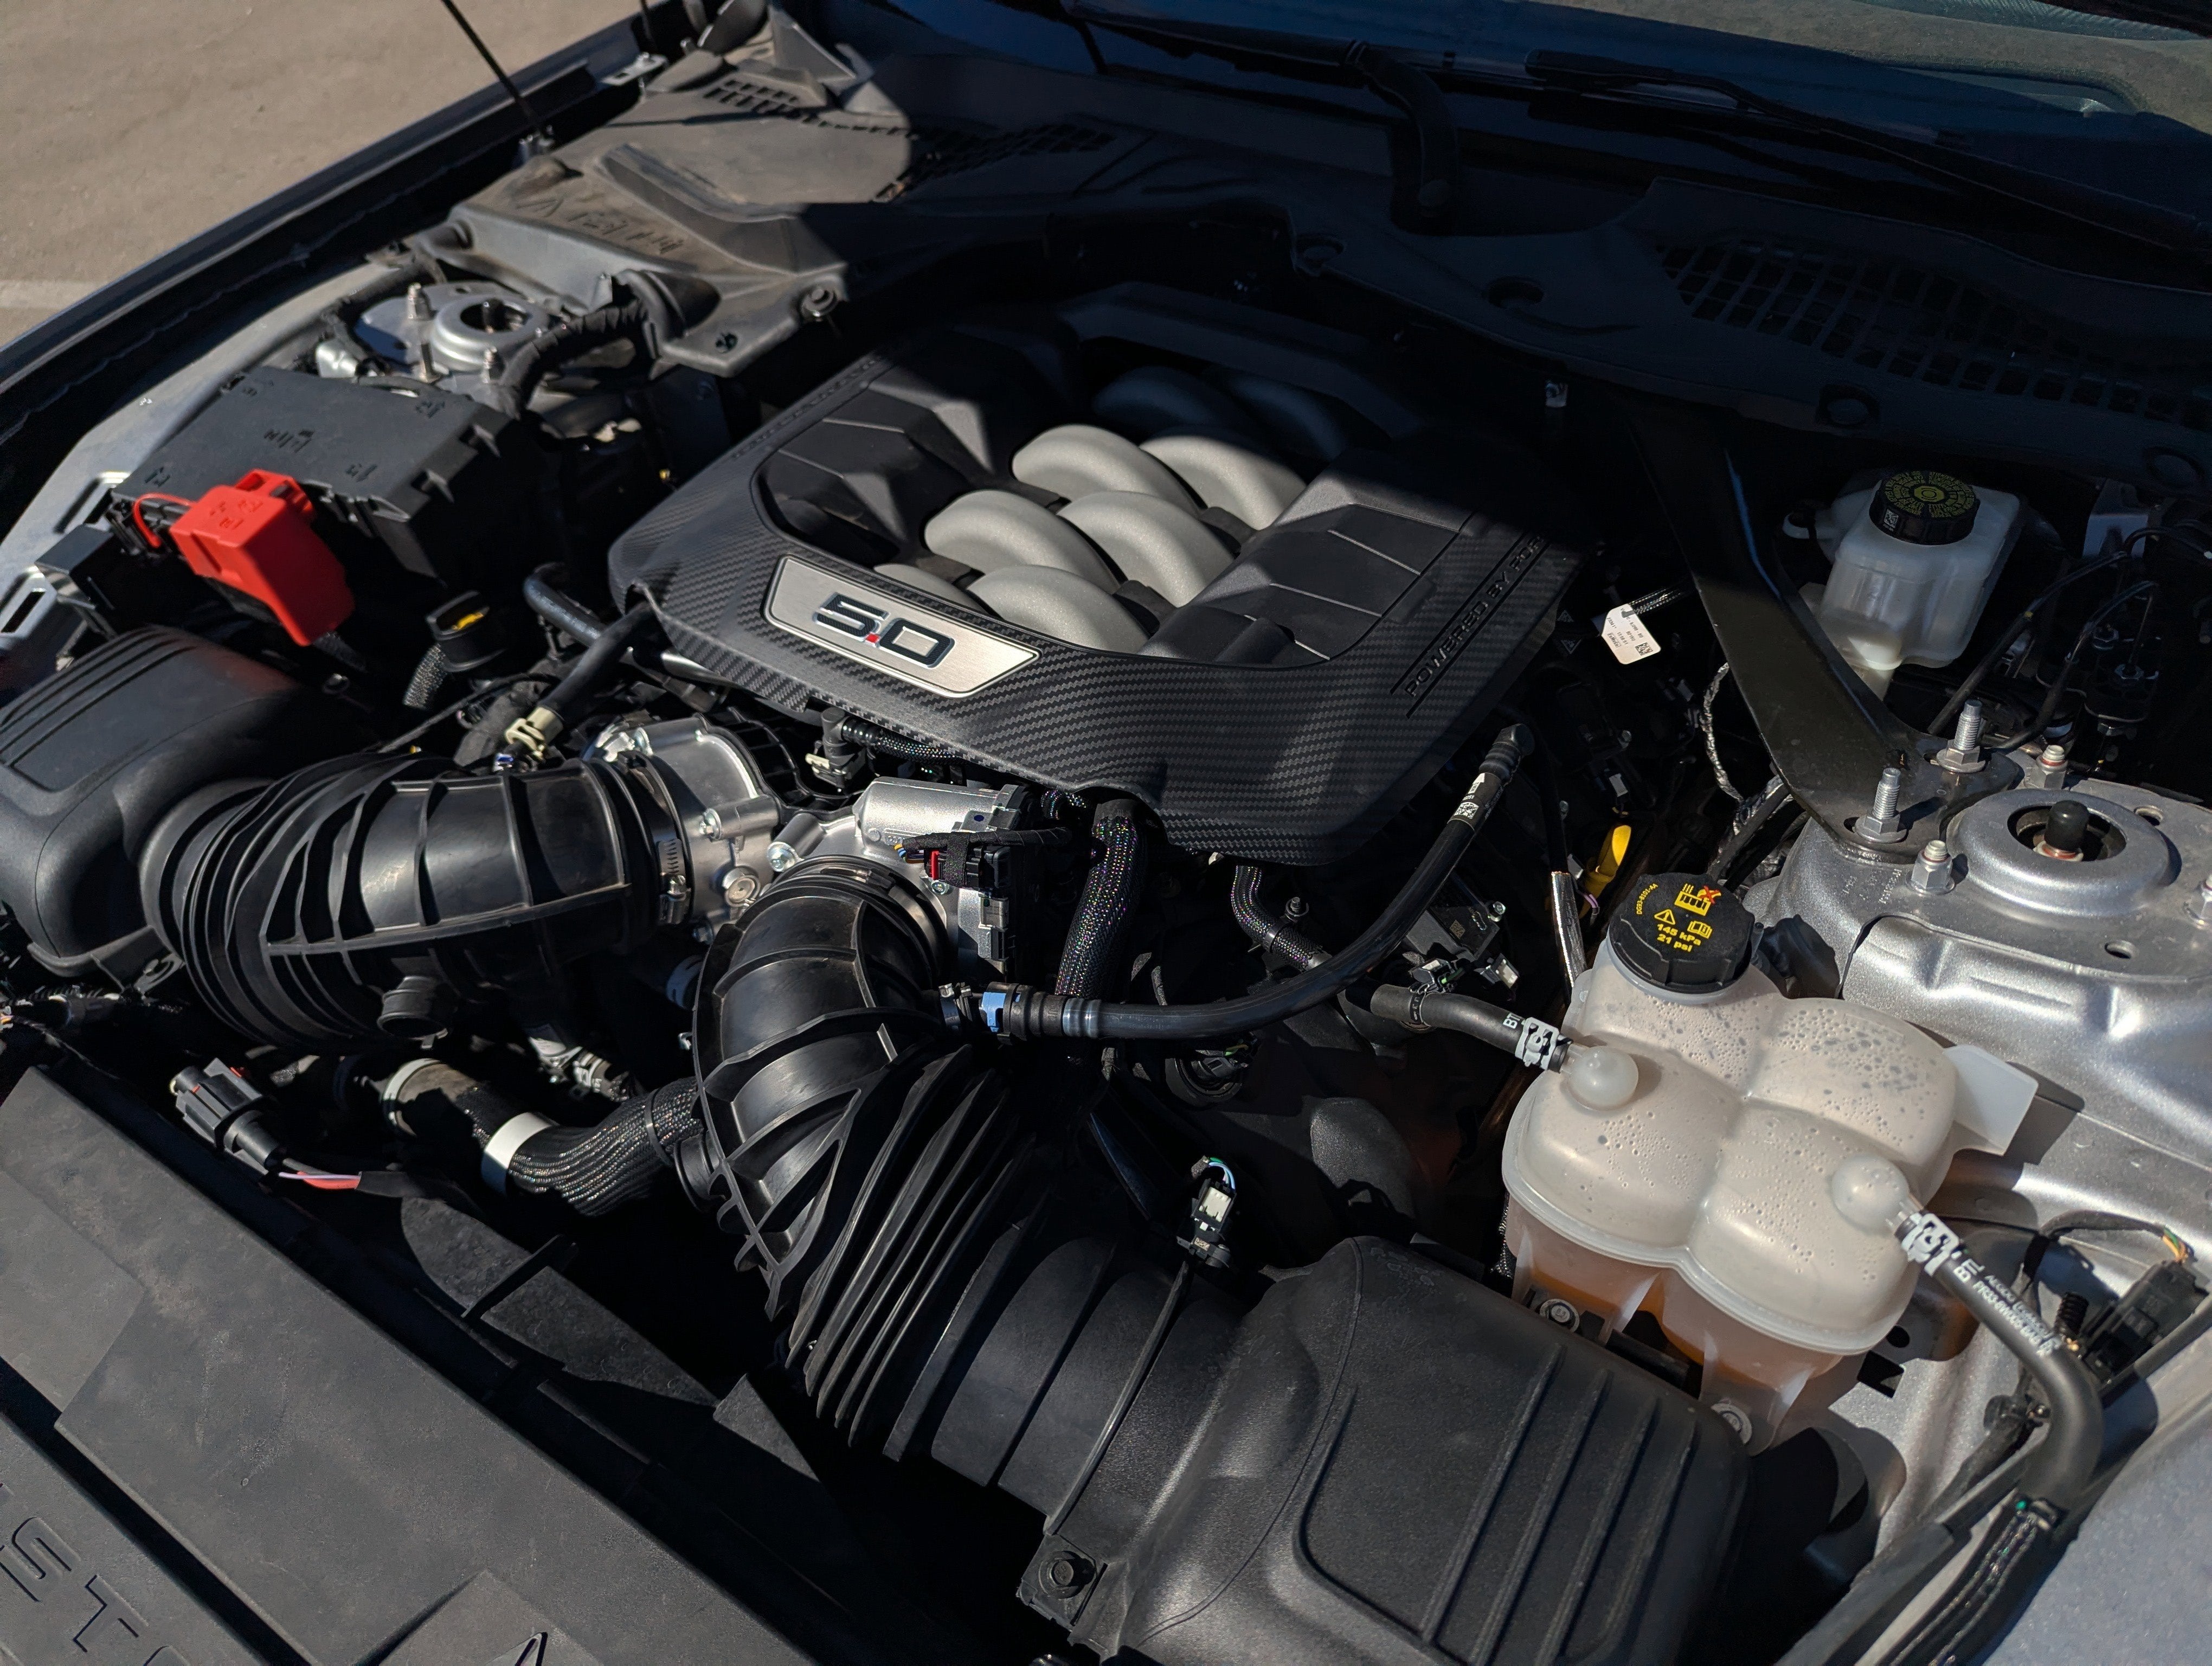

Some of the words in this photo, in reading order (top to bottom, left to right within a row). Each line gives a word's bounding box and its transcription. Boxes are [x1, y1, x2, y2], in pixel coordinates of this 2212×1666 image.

[812, 592, 956, 670] 5.0
[1404, 600, 1489, 698] POWERED
[1486, 571, 1510, 598] BY
[1509, 536, 1545, 572] FOR
[1657, 924, 1679, 936] 145
[1679, 932, 1701, 946] kPa
[1657, 933, 1672, 944] 21
[1673, 941, 1693, 952] psi
